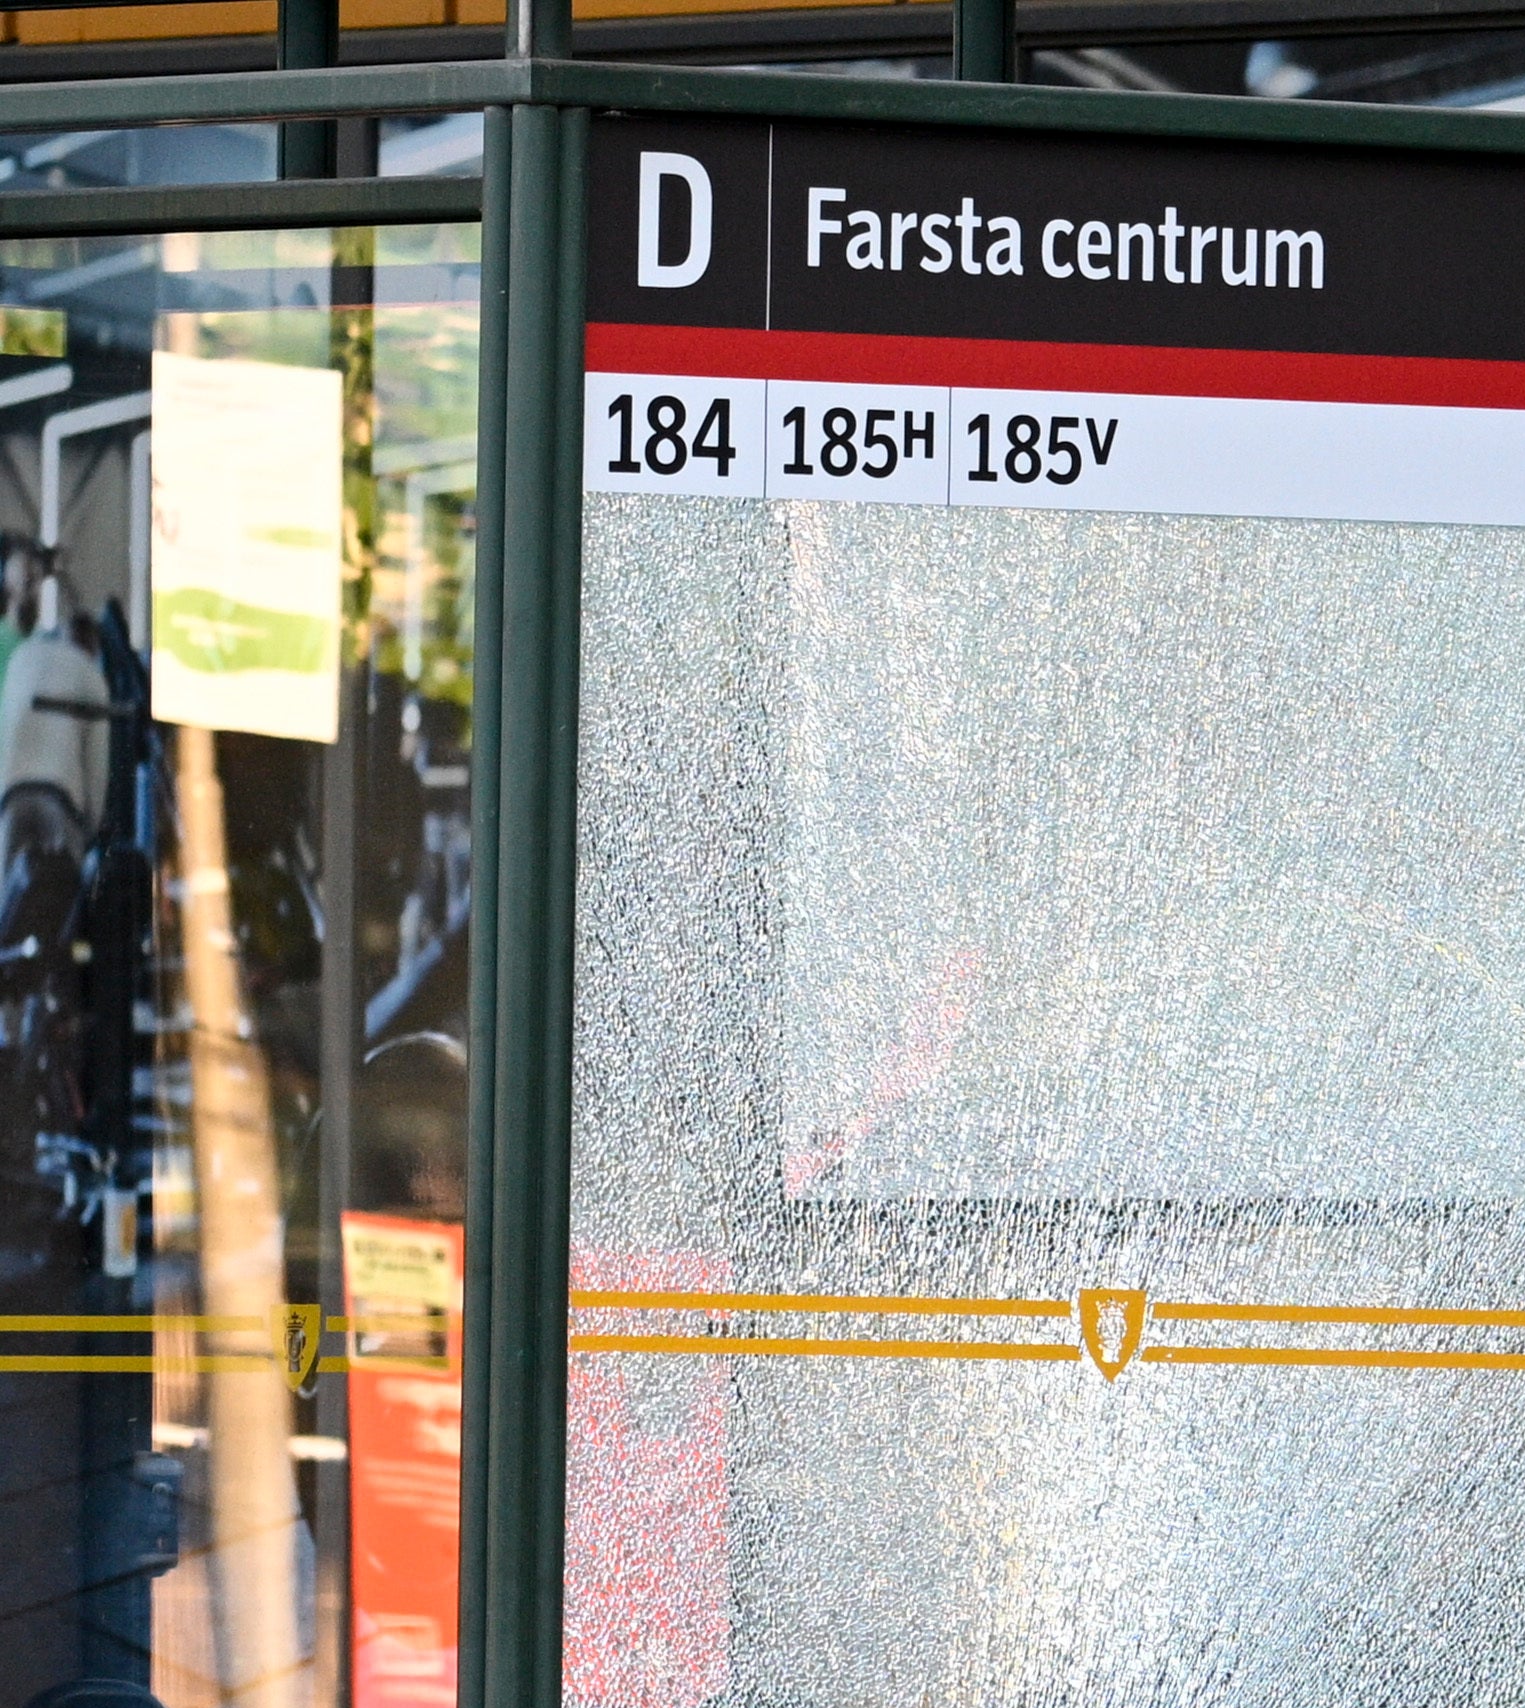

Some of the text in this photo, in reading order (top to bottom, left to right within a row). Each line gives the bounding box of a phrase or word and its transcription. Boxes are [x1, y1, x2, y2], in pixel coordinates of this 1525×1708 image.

[638, 151, 713, 288] D
[807, 187, 1324, 289] Farsta centrum
[608, 394, 736, 477] 184
[783, 406, 934, 478] 185H
[967, 413, 1118, 485] 185V
